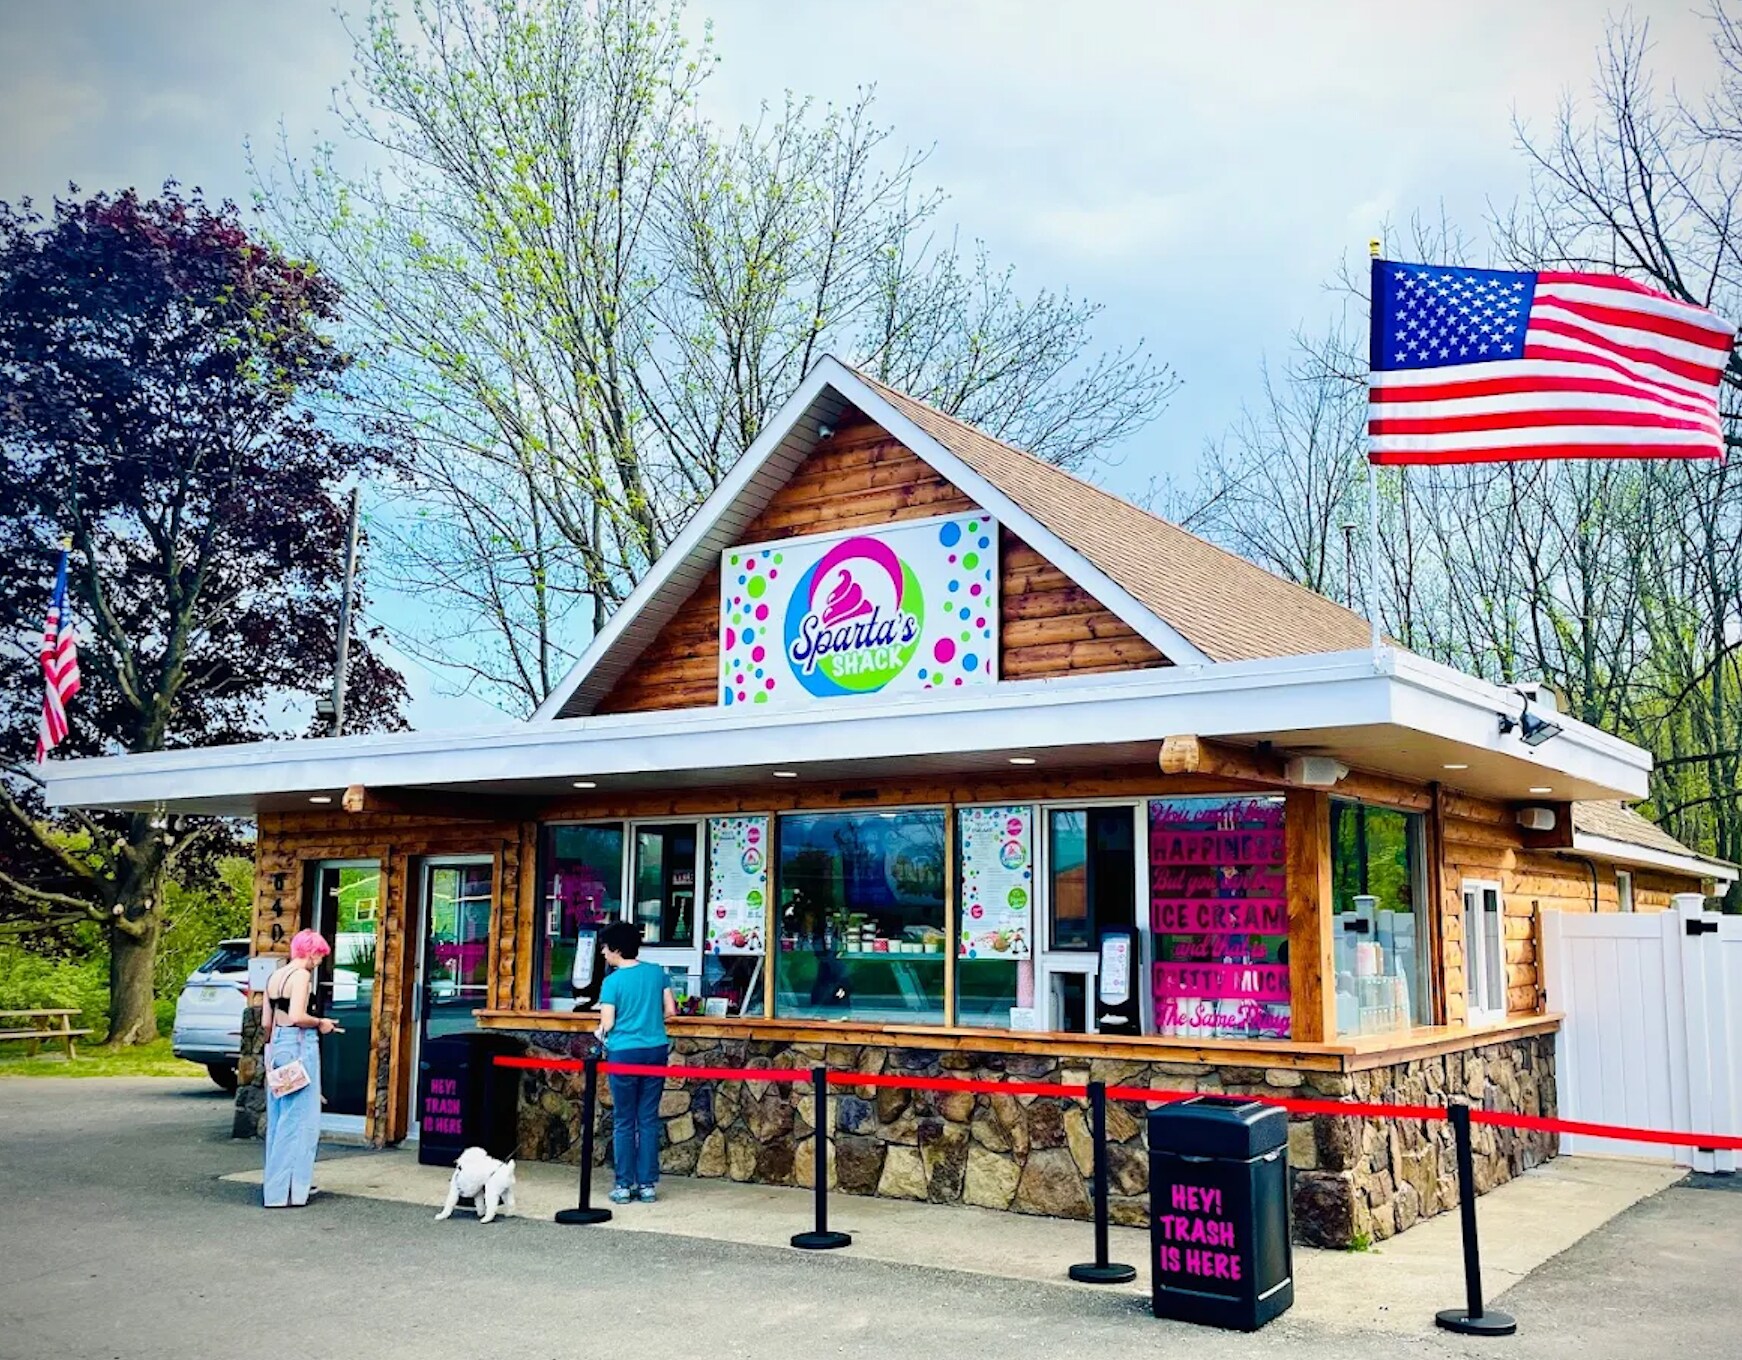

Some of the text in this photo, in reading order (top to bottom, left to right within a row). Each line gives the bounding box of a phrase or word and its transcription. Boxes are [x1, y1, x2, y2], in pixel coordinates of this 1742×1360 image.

[792, 605, 917, 671] Sparta's
[831, 648, 904, 677] SHACK
[1154, 835, 1283, 861] HAPPINESS
[1153, 867, 1186, 890] But
[1184, 876, 1217, 898] you
[1154, 903, 1287, 930] ICE CREAM
[1156, 967, 1289, 992] PRETTY MUCH
[1158, 999, 1188, 1027] The
[1189, 1003, 1236, 1028] Same
[431, 1079, 456, 1095] HEY!
[425, 1097, 460, 1115] TRASH
[424, 1116, 463, 1135] IS HERE
[1171, 1184, 1223, 1216] HEY!
[1160, 1214, 1235, 1249] TRASH
[1160, 1245, 1242, 1281] IS HERE
